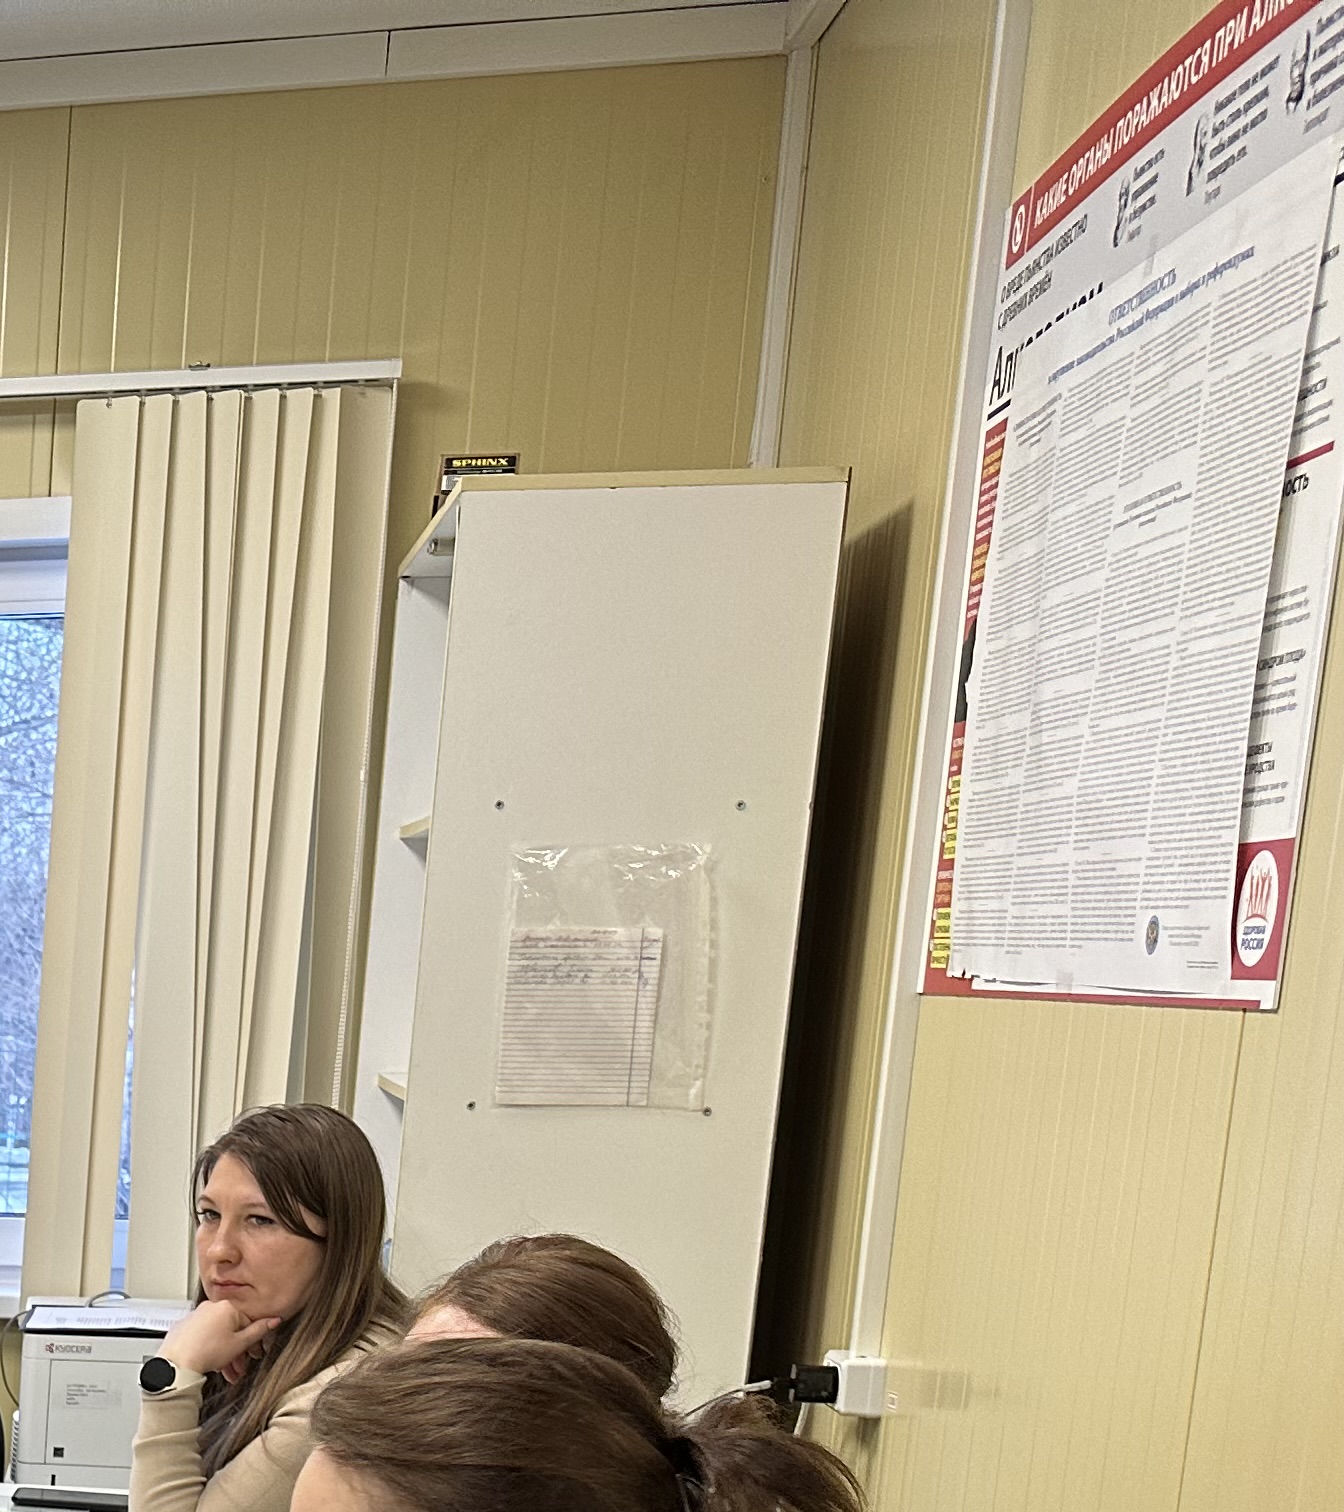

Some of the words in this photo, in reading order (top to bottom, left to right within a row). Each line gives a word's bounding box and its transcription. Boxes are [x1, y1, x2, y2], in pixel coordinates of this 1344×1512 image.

[1034, 172, 1069, 229] КАКИЕ
[1068, 128, 1114, 196] ОРГАНЫ
[1113, 38, 1211, 154] ПОРАЖАЮТСЯ
[1212, 6, 1248, 68] ПРИ
[451, 457, 509, 467] SPHINX
